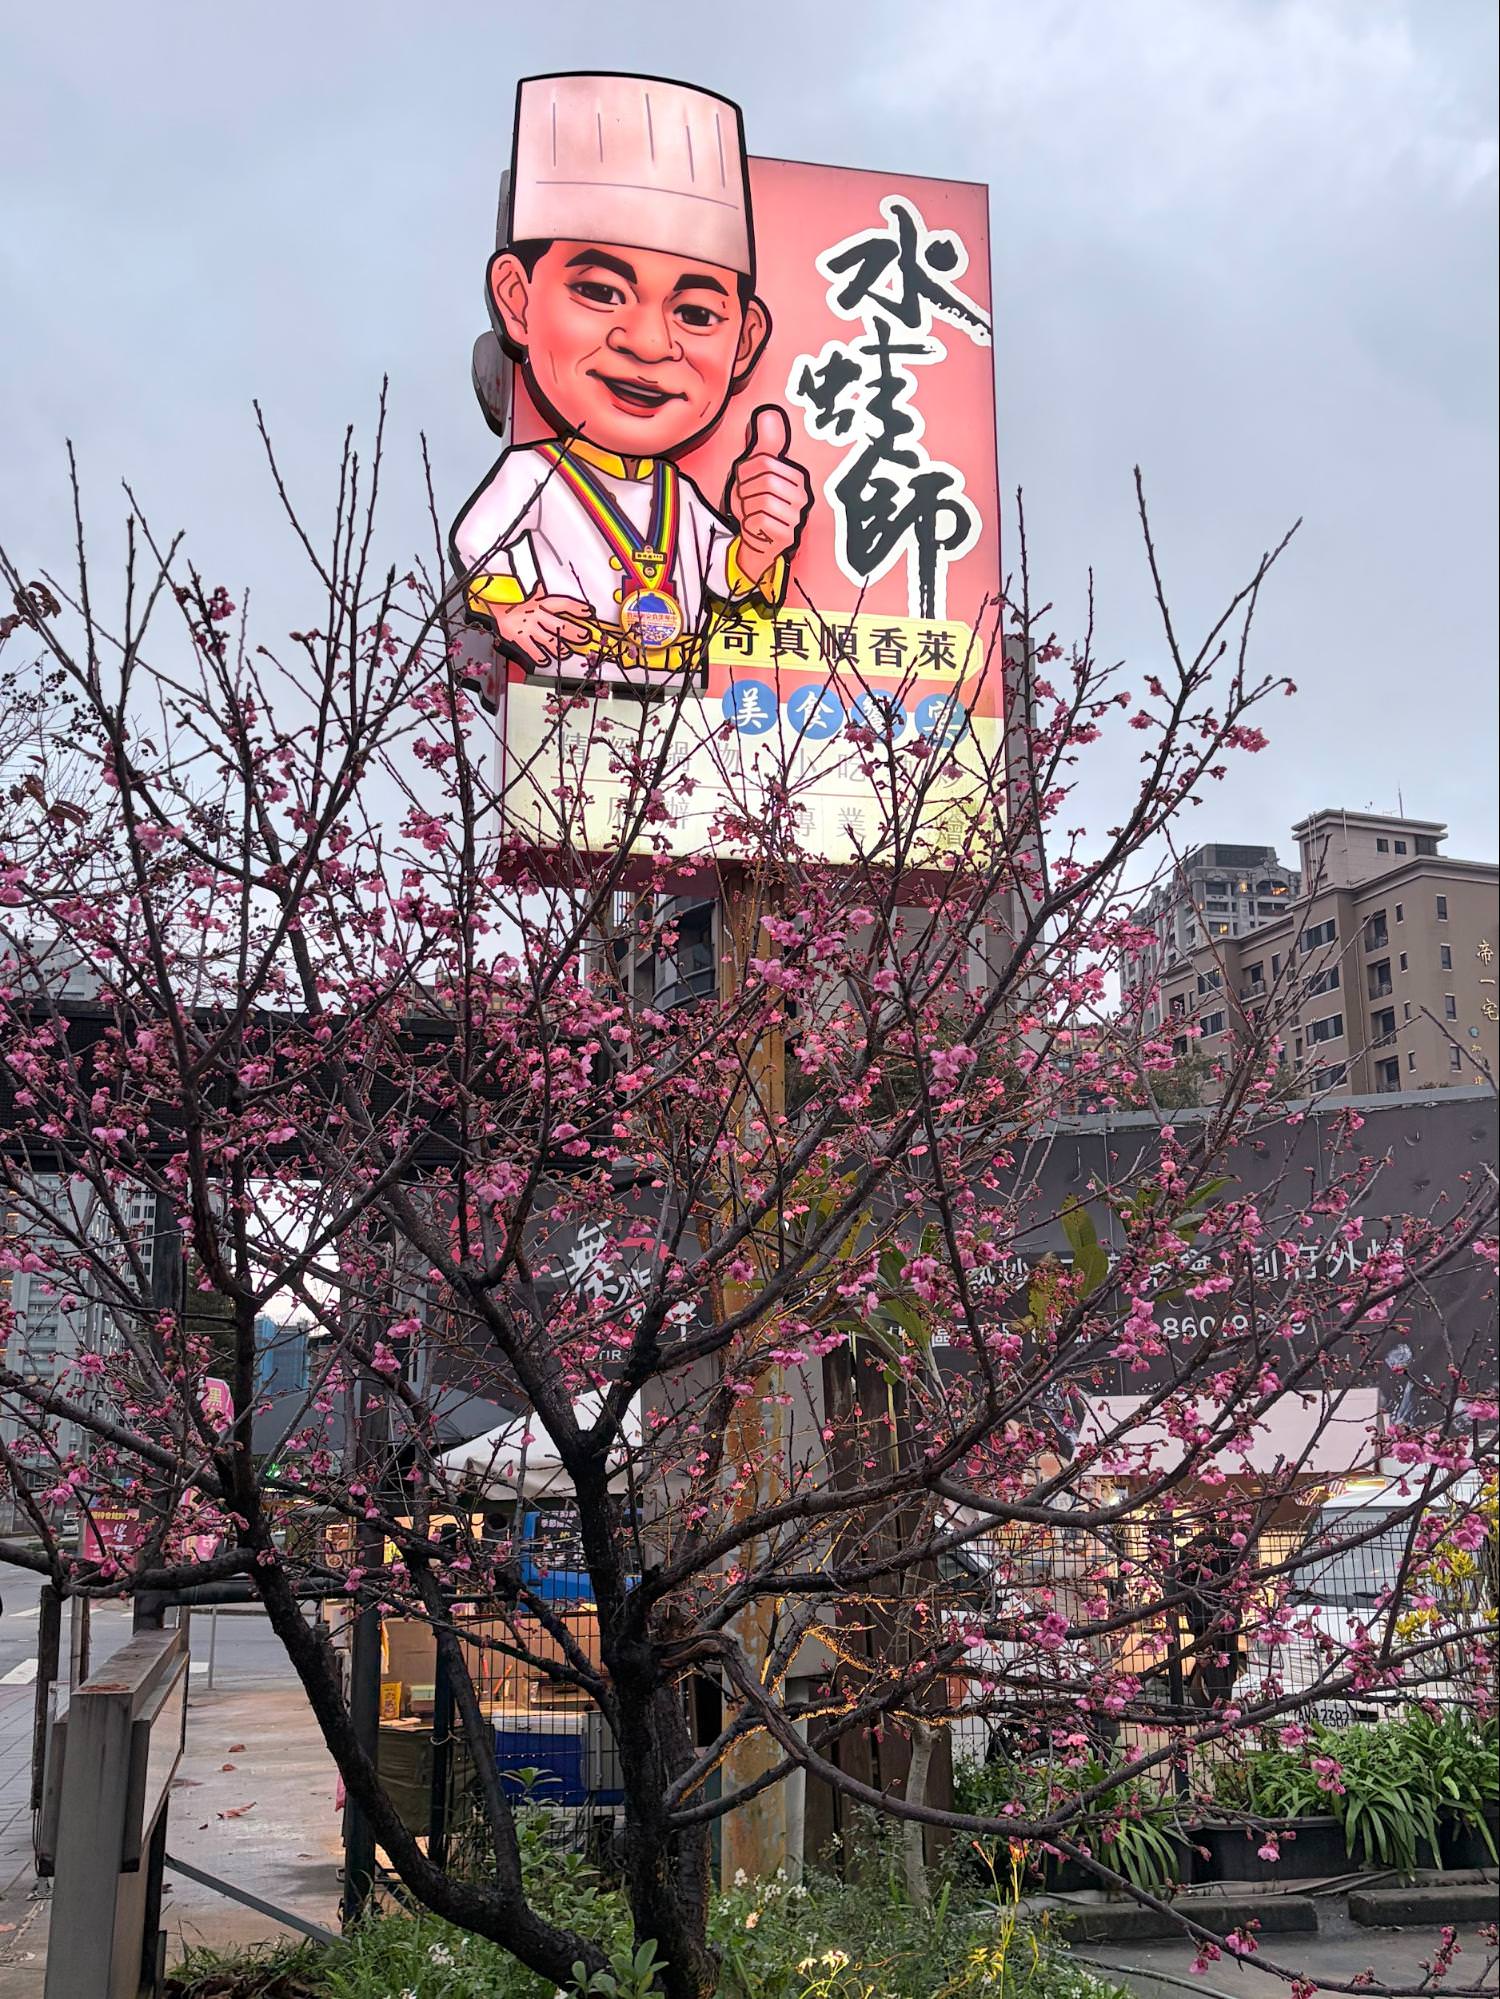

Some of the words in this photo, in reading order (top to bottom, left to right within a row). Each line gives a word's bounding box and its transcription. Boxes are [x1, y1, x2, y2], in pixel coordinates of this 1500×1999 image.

[797, 203, 992, 620] 水蛙師
[719, 615, 958, 671] 奇真順香萊
